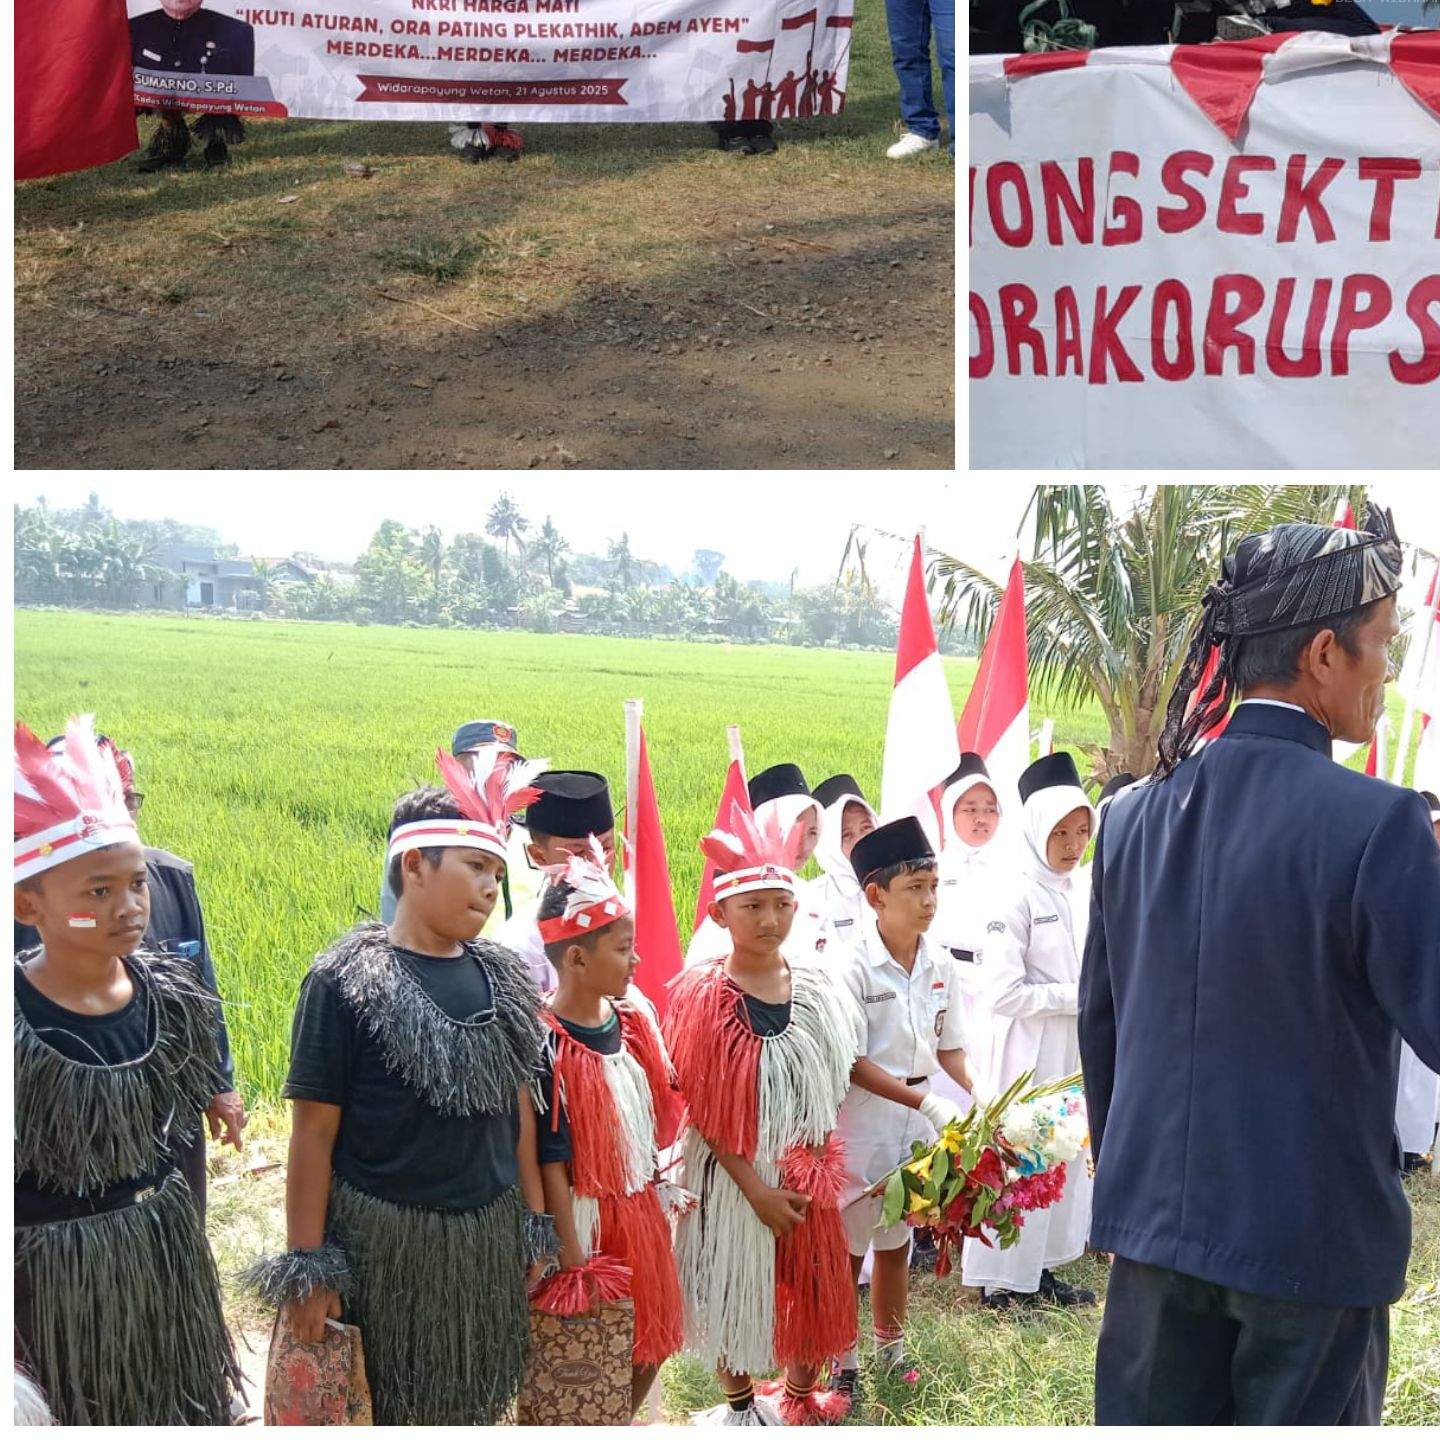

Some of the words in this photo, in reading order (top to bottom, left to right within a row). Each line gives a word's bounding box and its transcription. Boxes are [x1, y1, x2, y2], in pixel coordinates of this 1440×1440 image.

[301, 14, 384, 36] ATURAN,
[390, 19, 432, 37] ORA
[437, 21, 507, 39] PATING
[514, 22, 624, 40] PLEKATHIK,
[630, 19, 682, 38] ADEM
[553, 45, 658, 64] MERDEKA...
[134, 72, 200, 92] SUMARNO,
[203, 80, 238, 94] S.Pd.
[377, 81, 468, 101] Widarapayung
[470, 86, 513, 99] Wetan,
[514, 86, 529, 97] 21
[530, 85, 580, 100] Agustus
[580, 84, 609, 96] 2025
